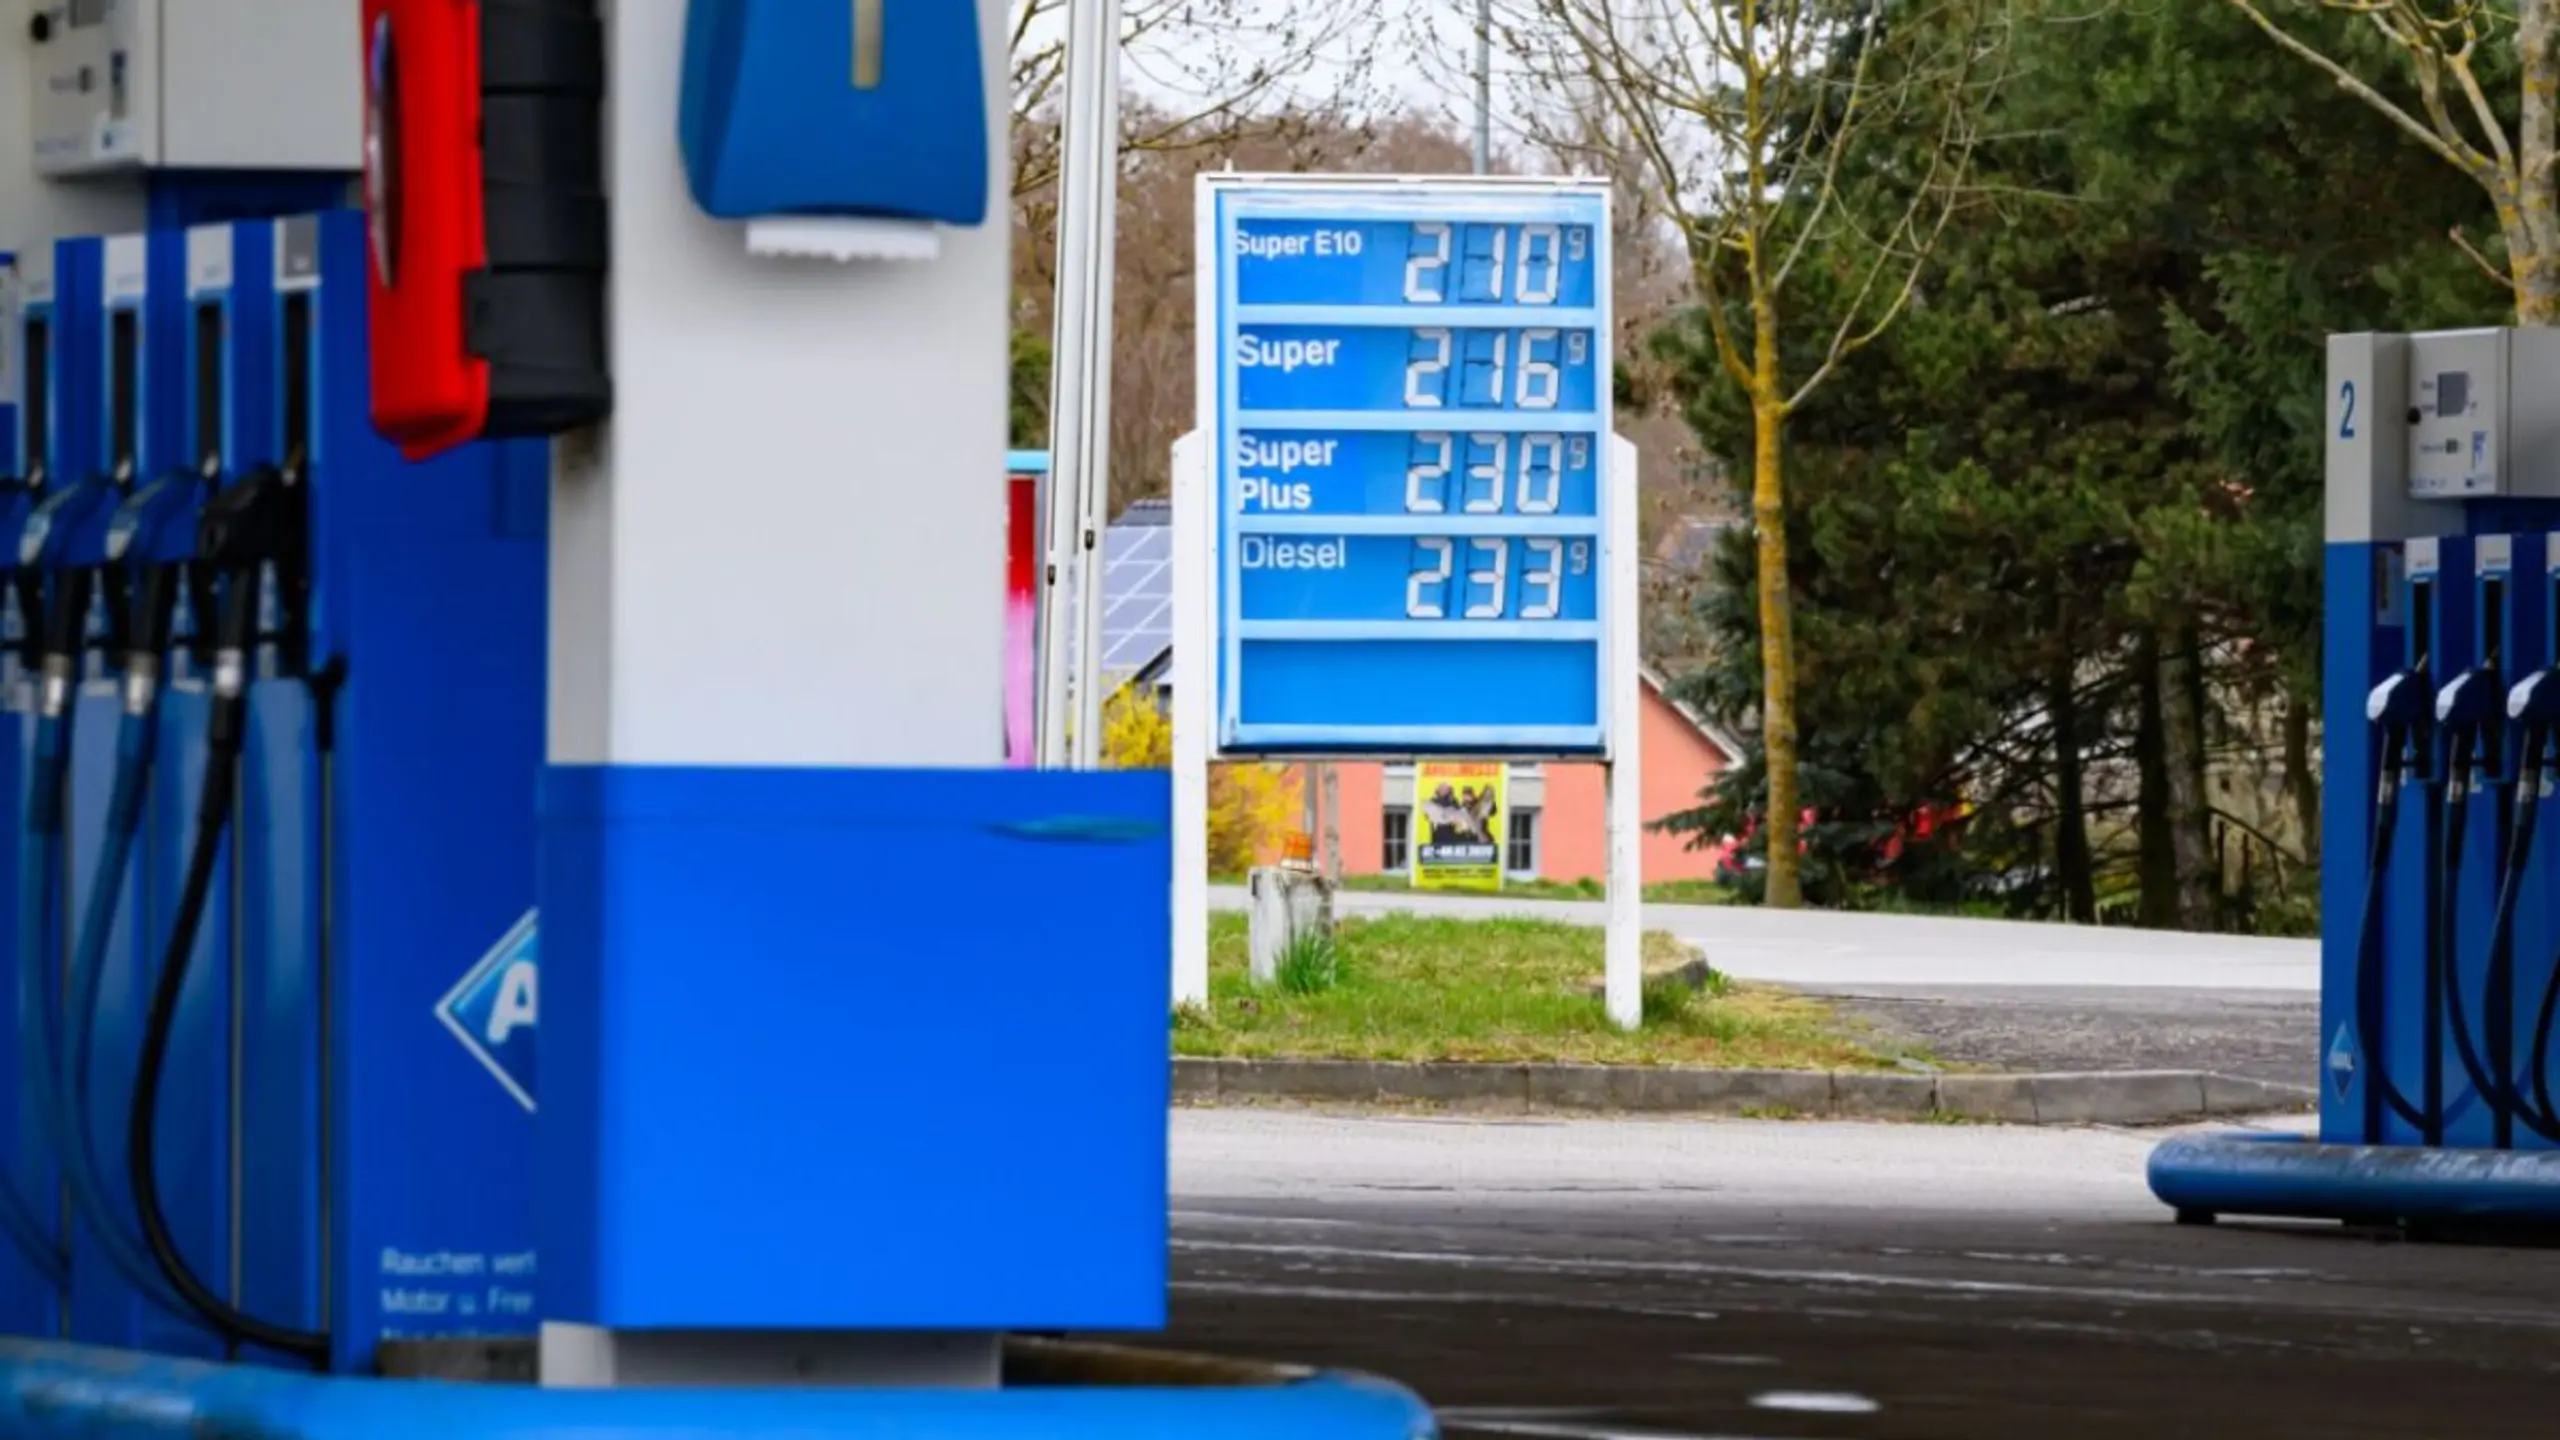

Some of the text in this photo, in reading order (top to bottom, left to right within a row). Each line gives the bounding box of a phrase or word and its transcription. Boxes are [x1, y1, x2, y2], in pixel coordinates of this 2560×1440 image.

[1235, 230, 1362, 260] Super E10
[1237, 333, 1341, 373] Super
[2339, 380, 2355, 439] 2
[1237, 434, 1338, 476] Super
[1239, 478, 1313, 511] Plus
[1240, 536, 1346, 570] Diesel
